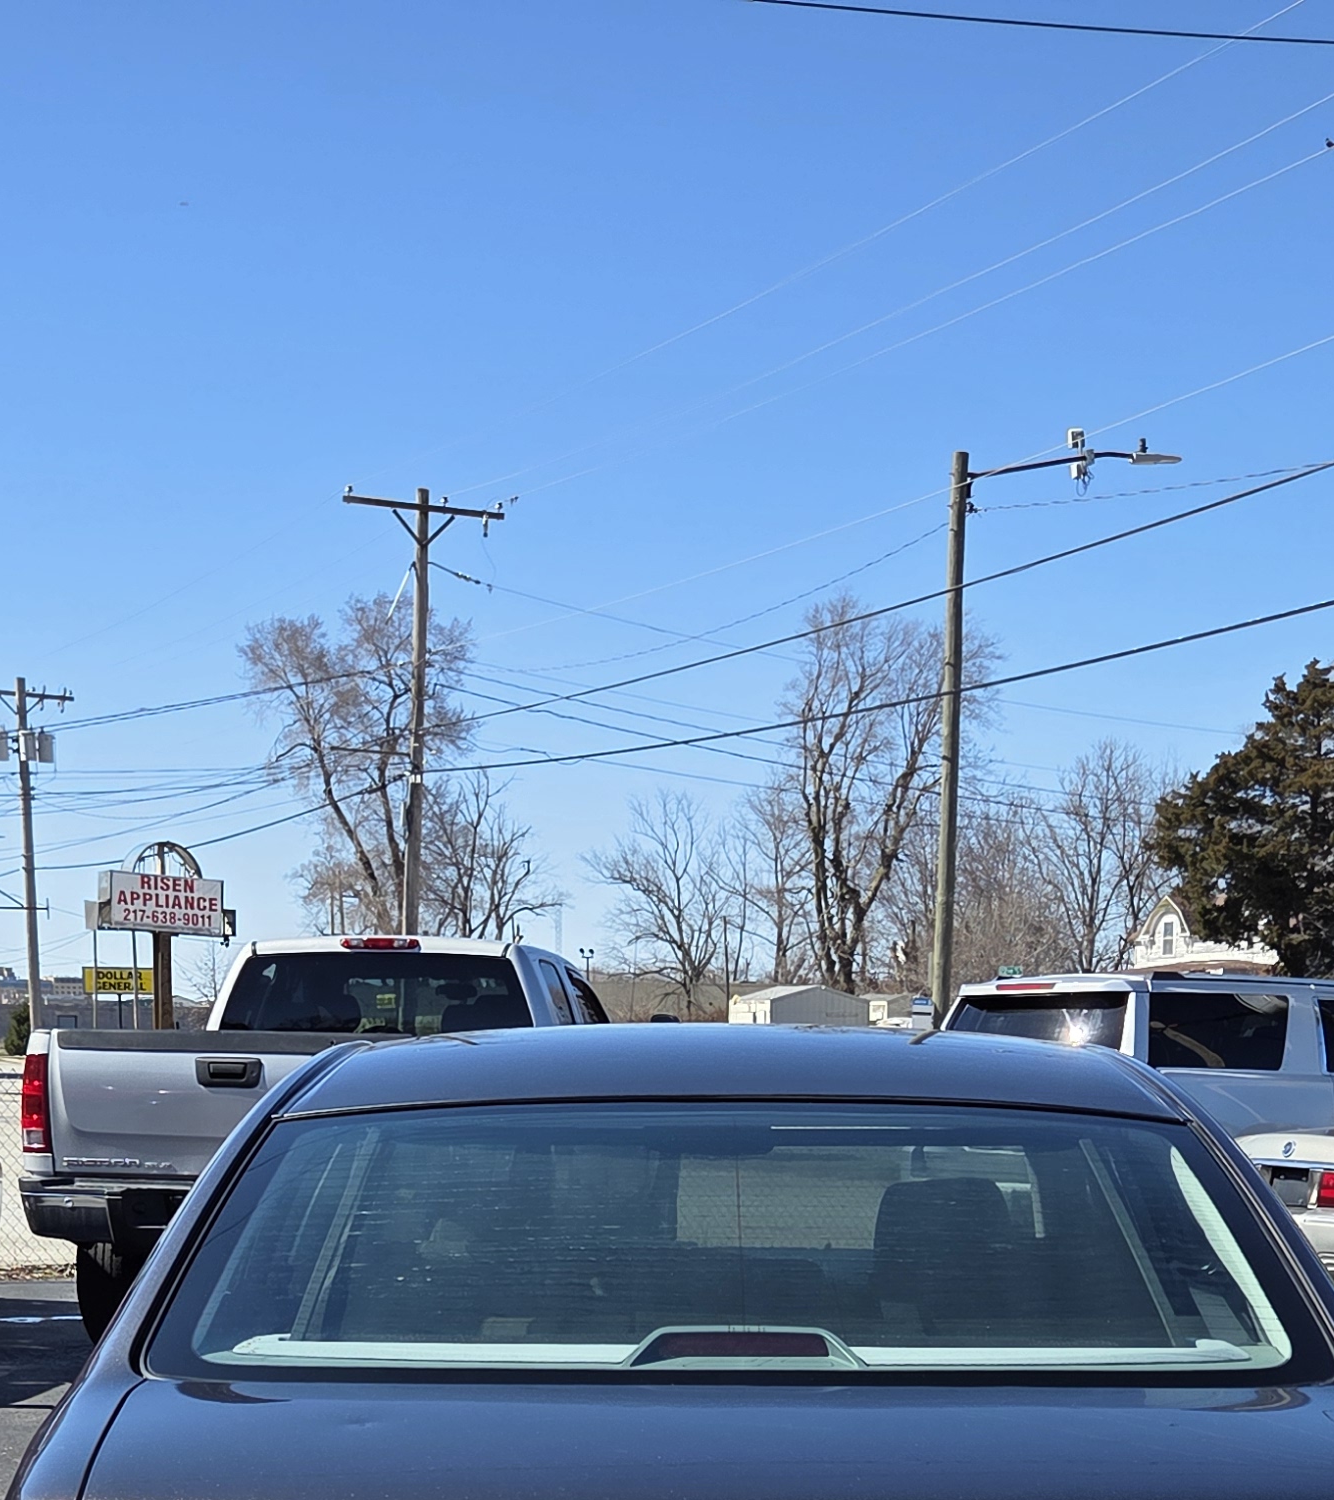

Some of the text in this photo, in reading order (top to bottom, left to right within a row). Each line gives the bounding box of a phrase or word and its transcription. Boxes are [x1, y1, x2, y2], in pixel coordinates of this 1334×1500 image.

[140, 874, 195, 894] RISEN
[117, 890, 218, 912] APPLIANCE
[123, 908, 212, 927] 217-638-9011
[97, 970, 143, 981] DOLLAR
[97, 981, 146, 991] GENERL
